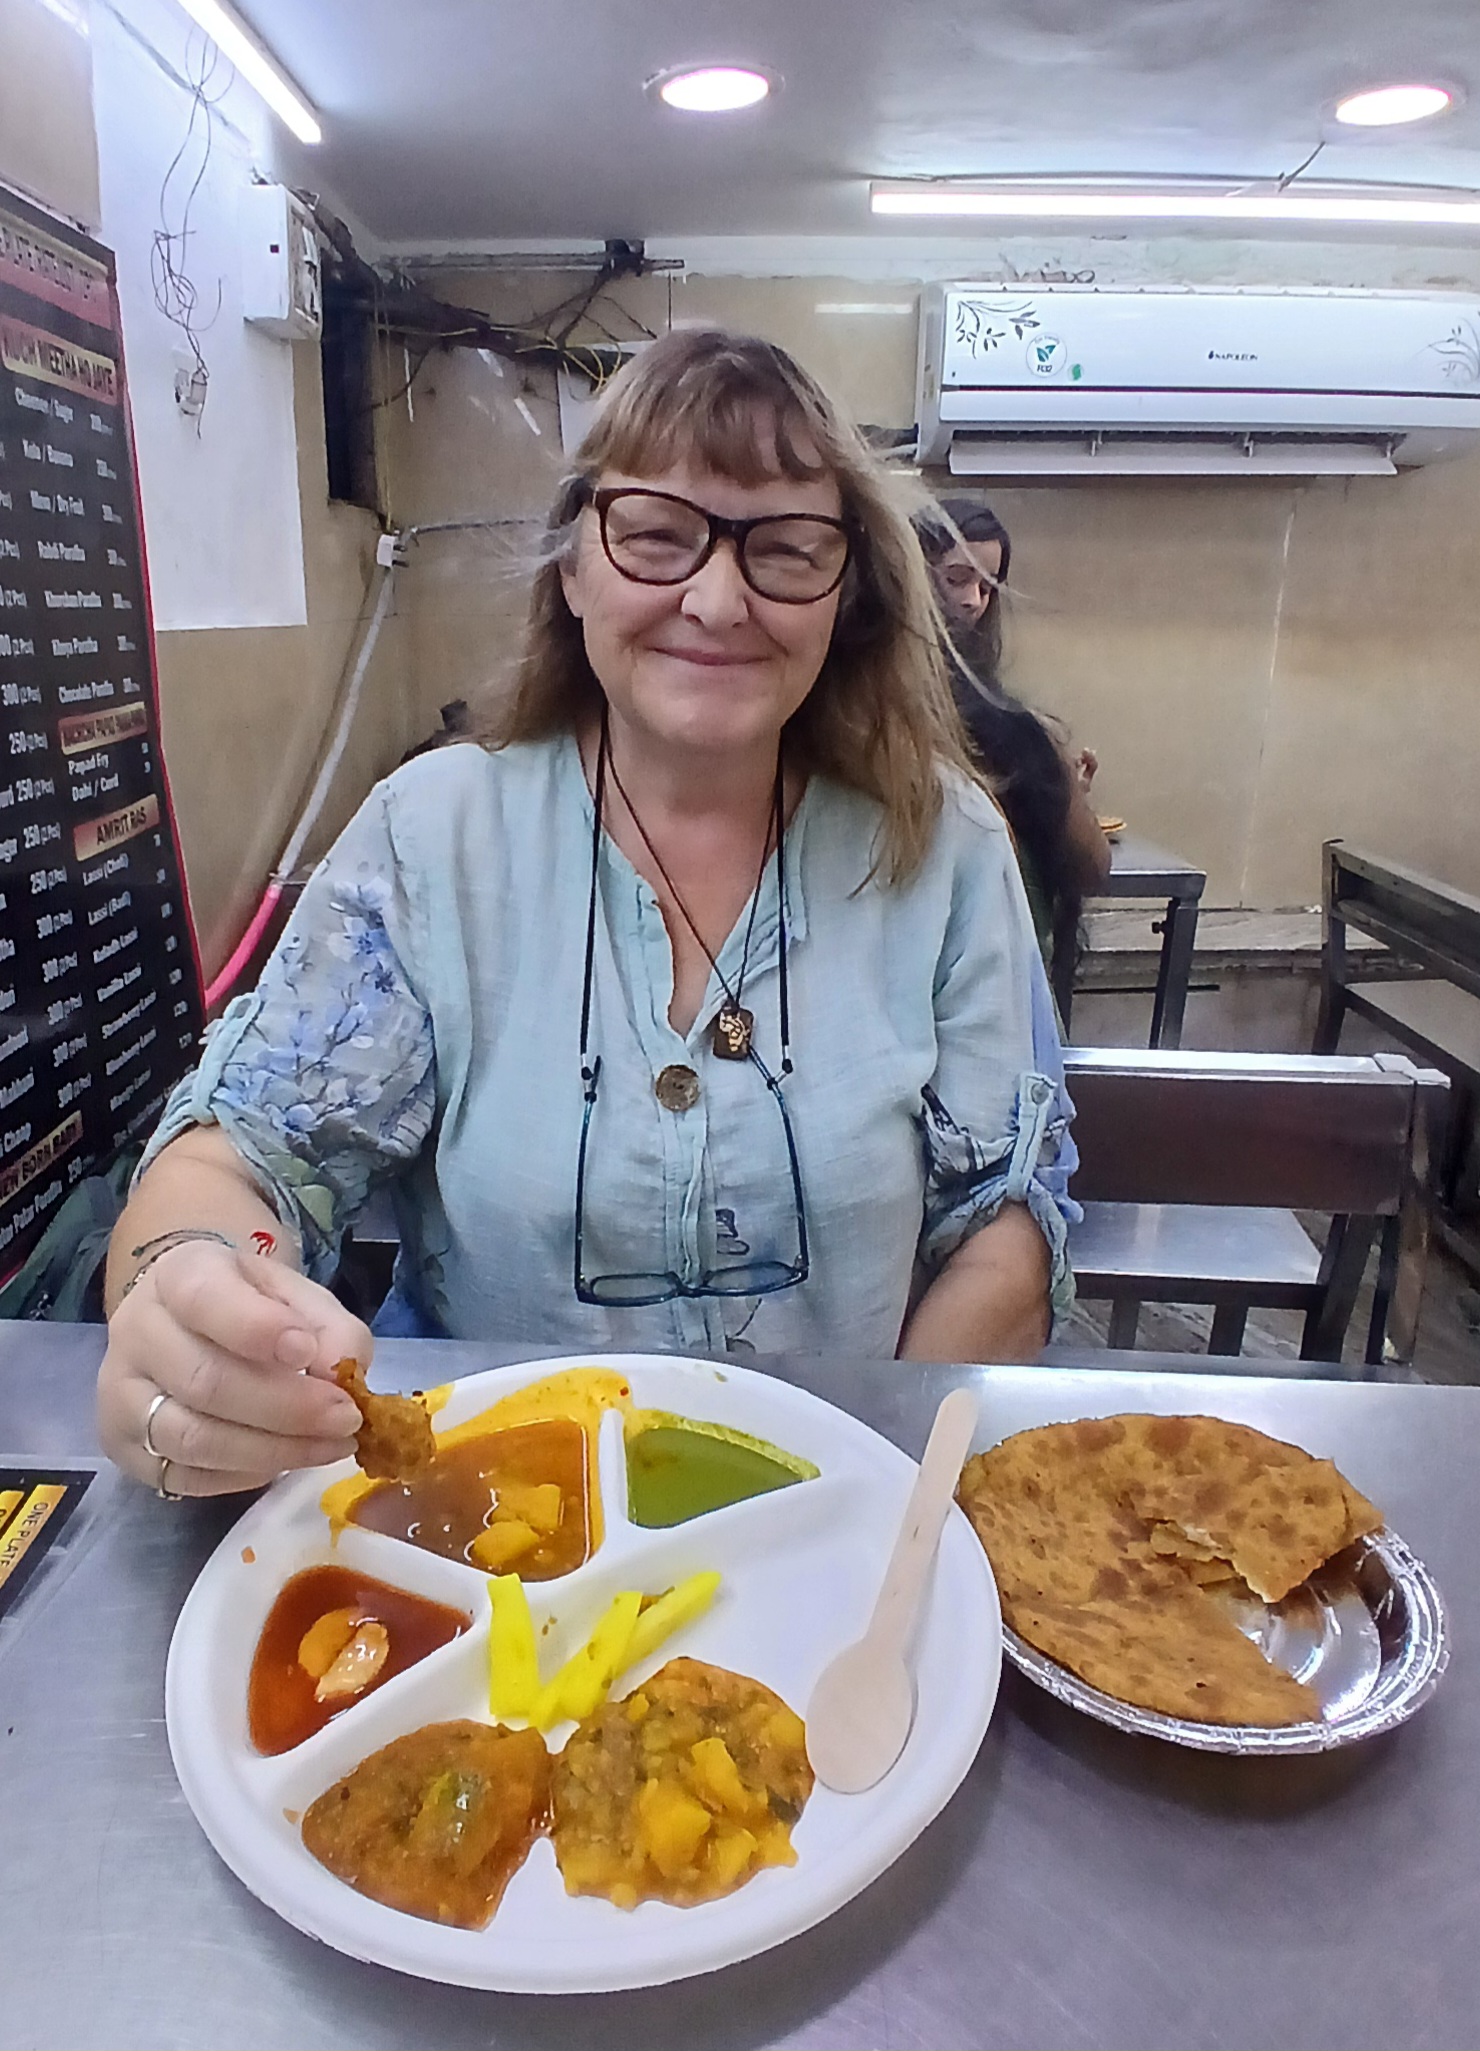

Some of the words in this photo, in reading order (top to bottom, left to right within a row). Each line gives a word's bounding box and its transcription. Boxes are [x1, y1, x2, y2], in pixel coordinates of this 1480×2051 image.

[16, 778, 33, 802] 250
[23, 824, 40, 849] 250
[96, 813, 129, 846] AMRIT
[30, 869, 47, 895] 250
[22, 1502, 49, 1527] ONE
